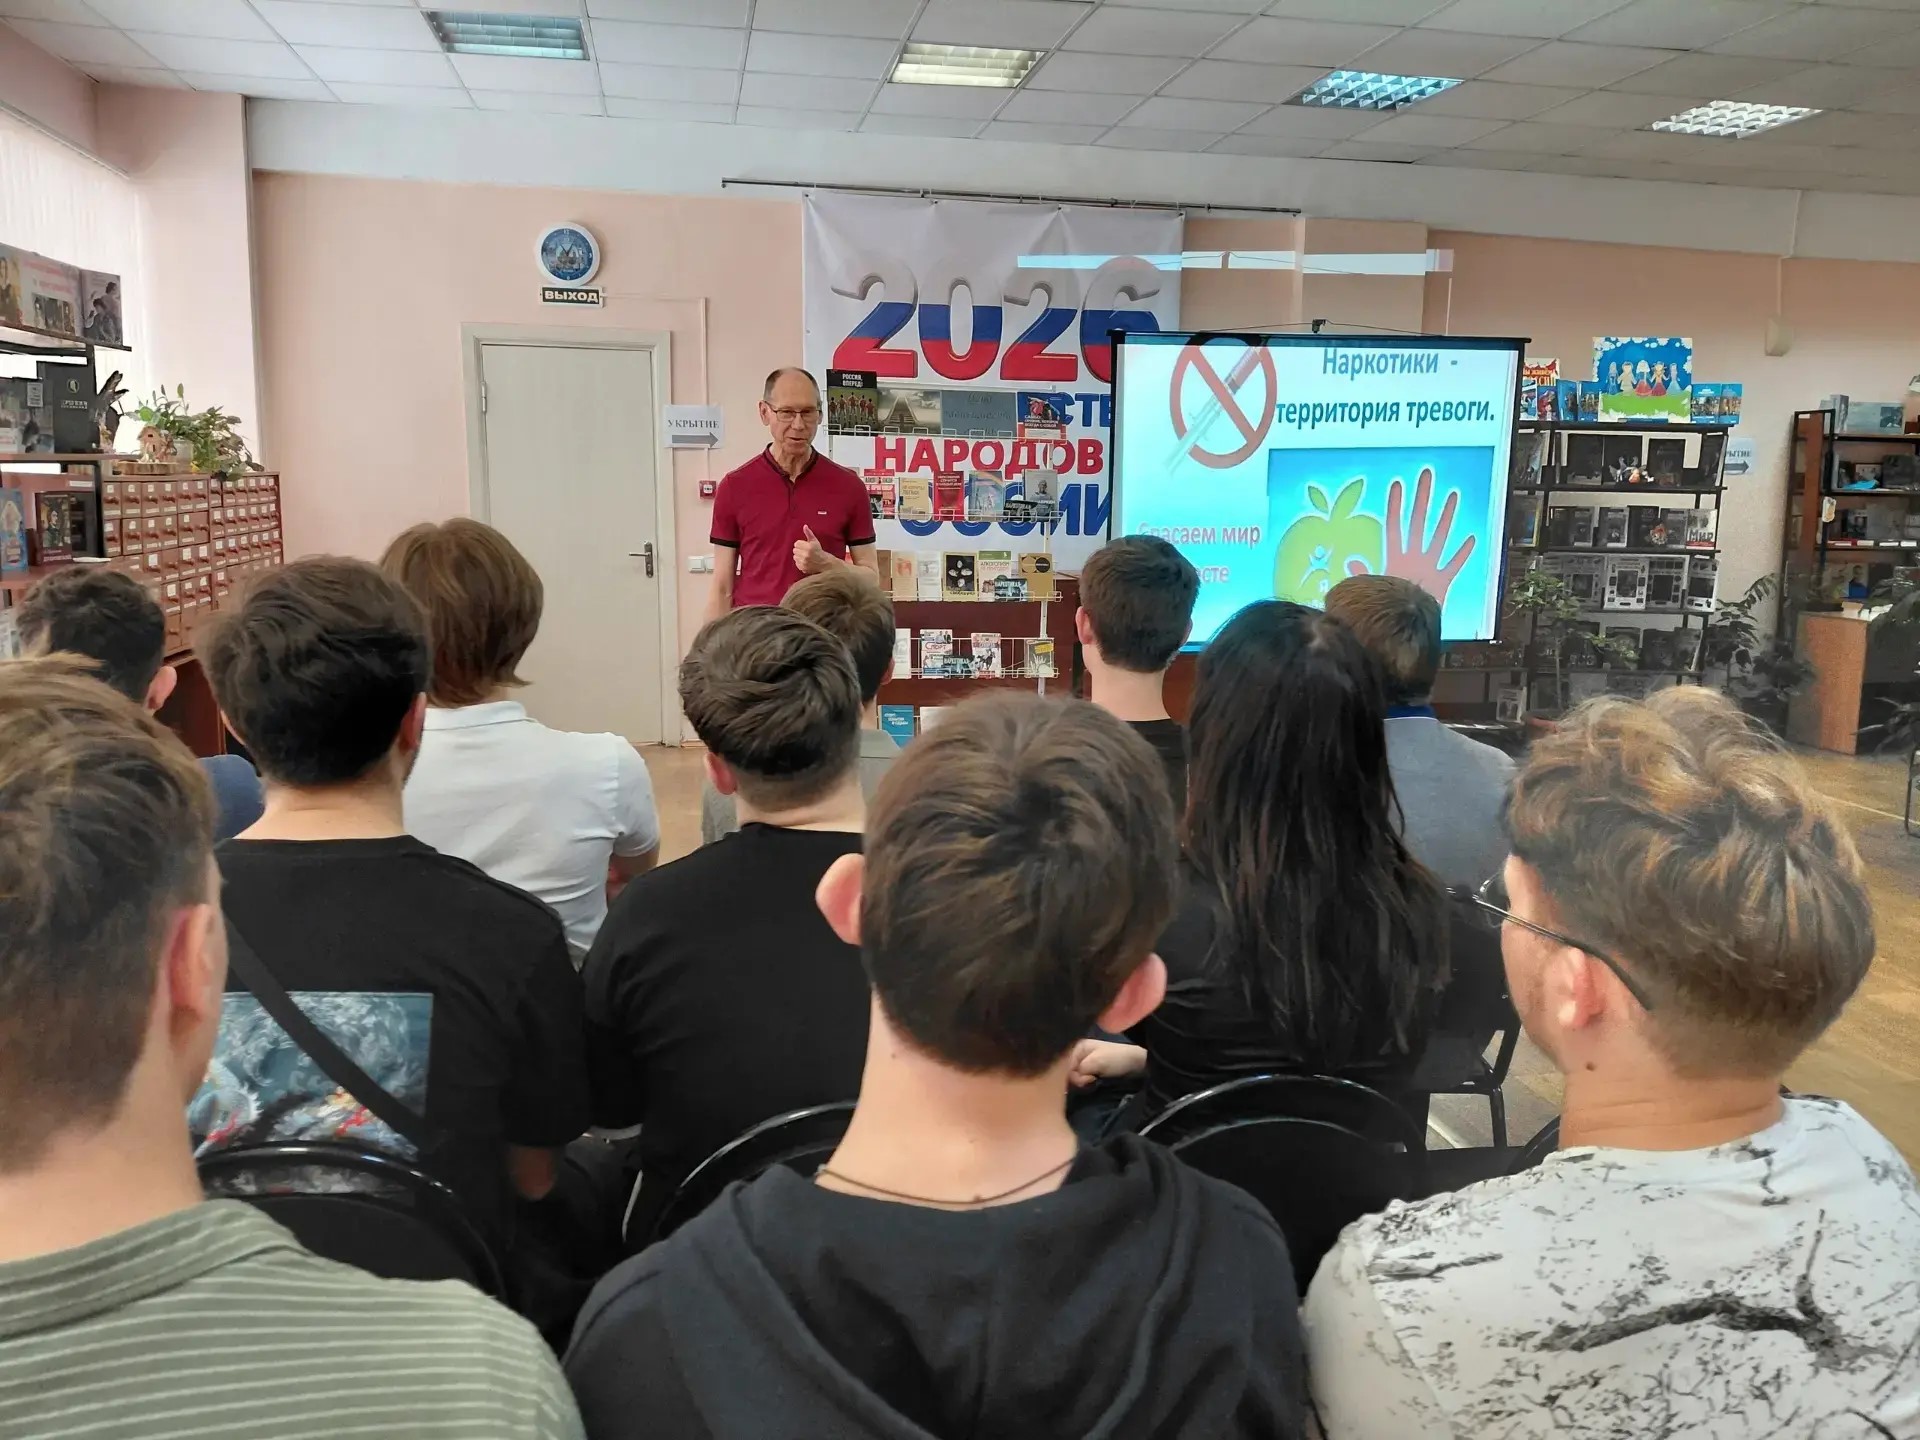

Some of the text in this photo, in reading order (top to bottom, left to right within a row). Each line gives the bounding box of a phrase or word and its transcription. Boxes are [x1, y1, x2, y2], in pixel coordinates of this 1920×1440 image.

[544, 290, 599, 303] ВЫХОД
[831, 255, 1160, 383] 2026
[1322, 347, 1439, 381] Наркотики
[668, 419, 720, 429] УКРЫТИЕ
[1276, 401, 1495, 430] территория тревоги.
[875, 437, 1104, 480] НАРОДОВ
[1222, 526, 1260, 549] мир
